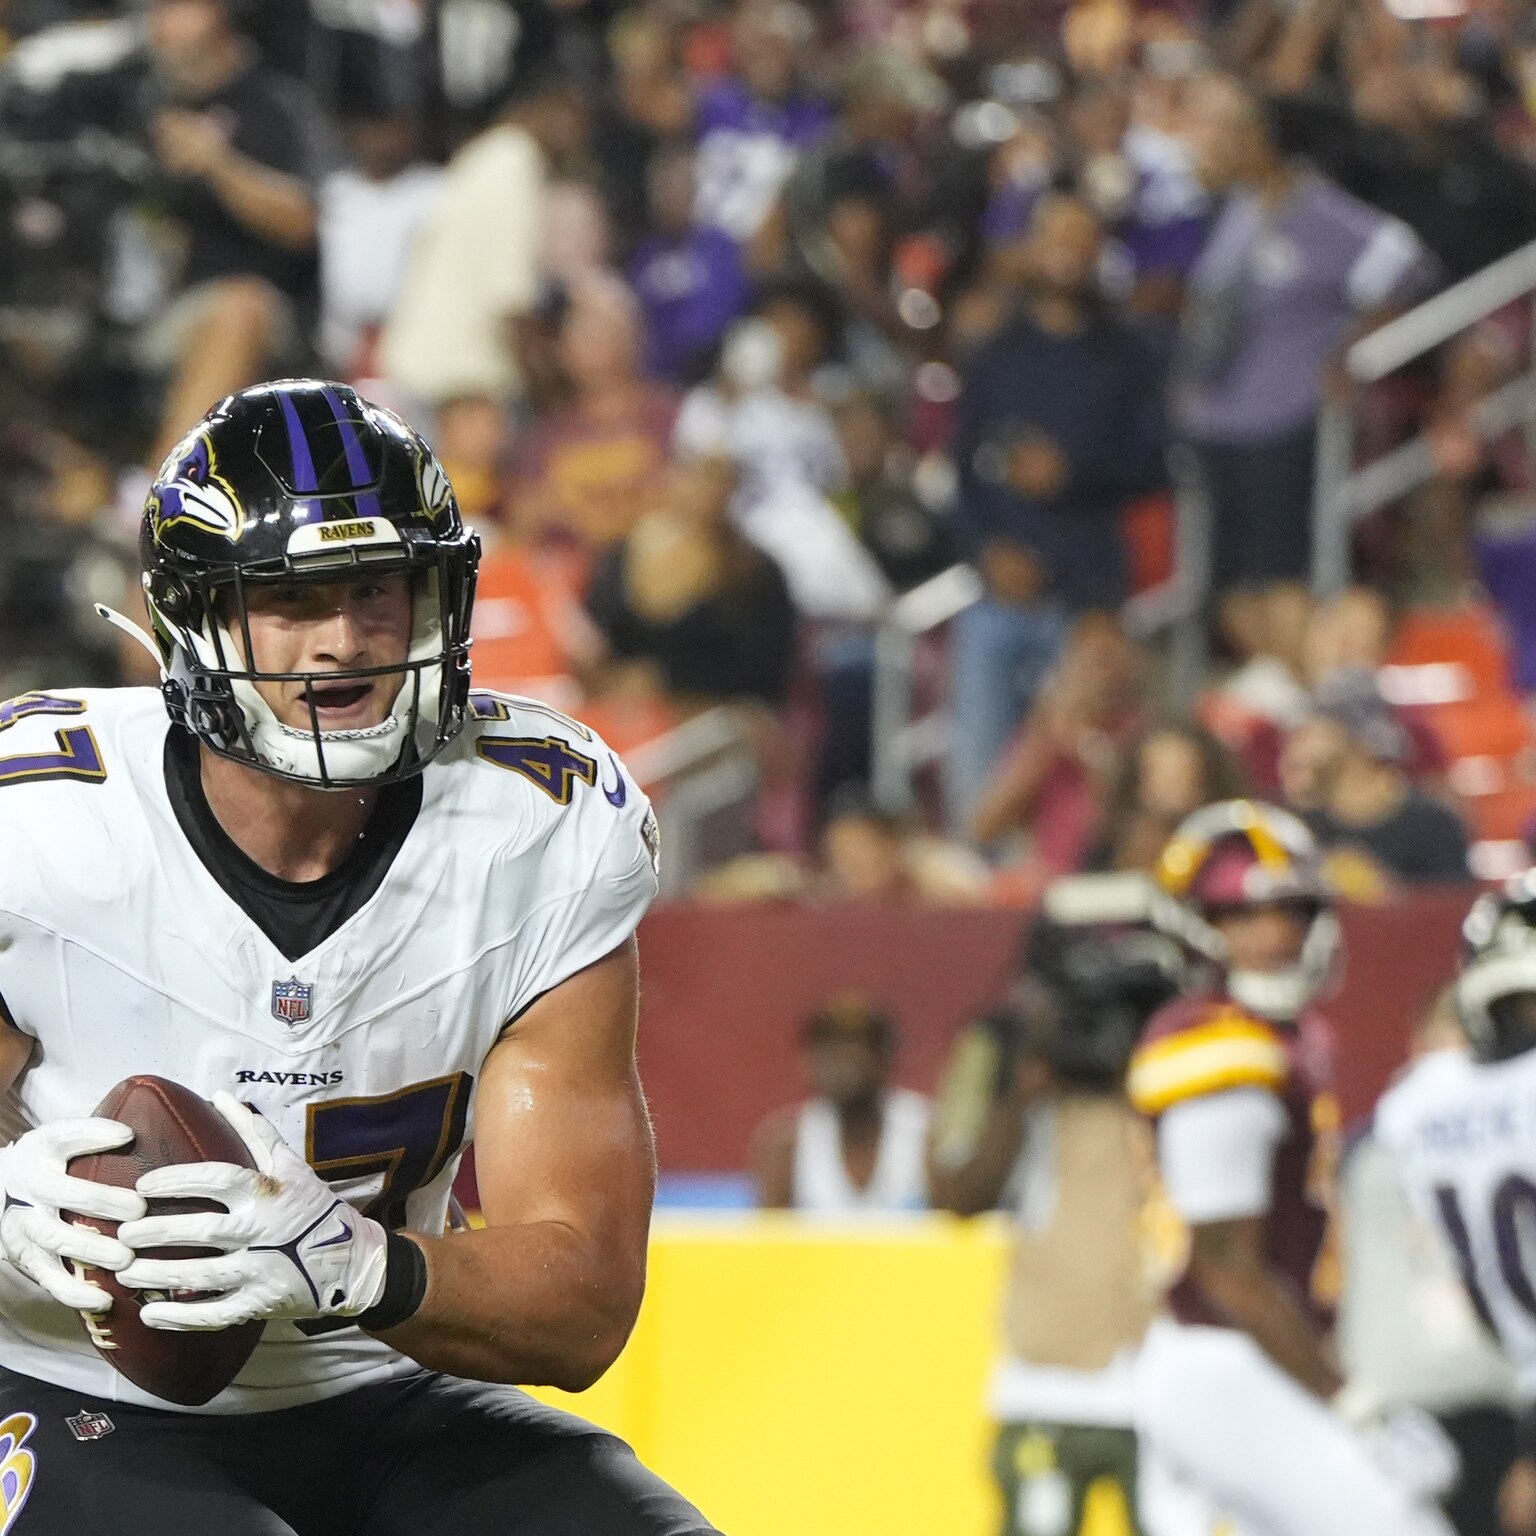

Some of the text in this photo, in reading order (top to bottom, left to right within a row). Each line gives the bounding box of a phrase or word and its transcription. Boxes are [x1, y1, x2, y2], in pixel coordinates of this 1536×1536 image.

[318, 521, 375, 541] RAVENS
[278, 999, 307, 1018] NFL
[236, 1070, 344, 1086] RAVENS
[246, 1070, 474, 1240] 7
